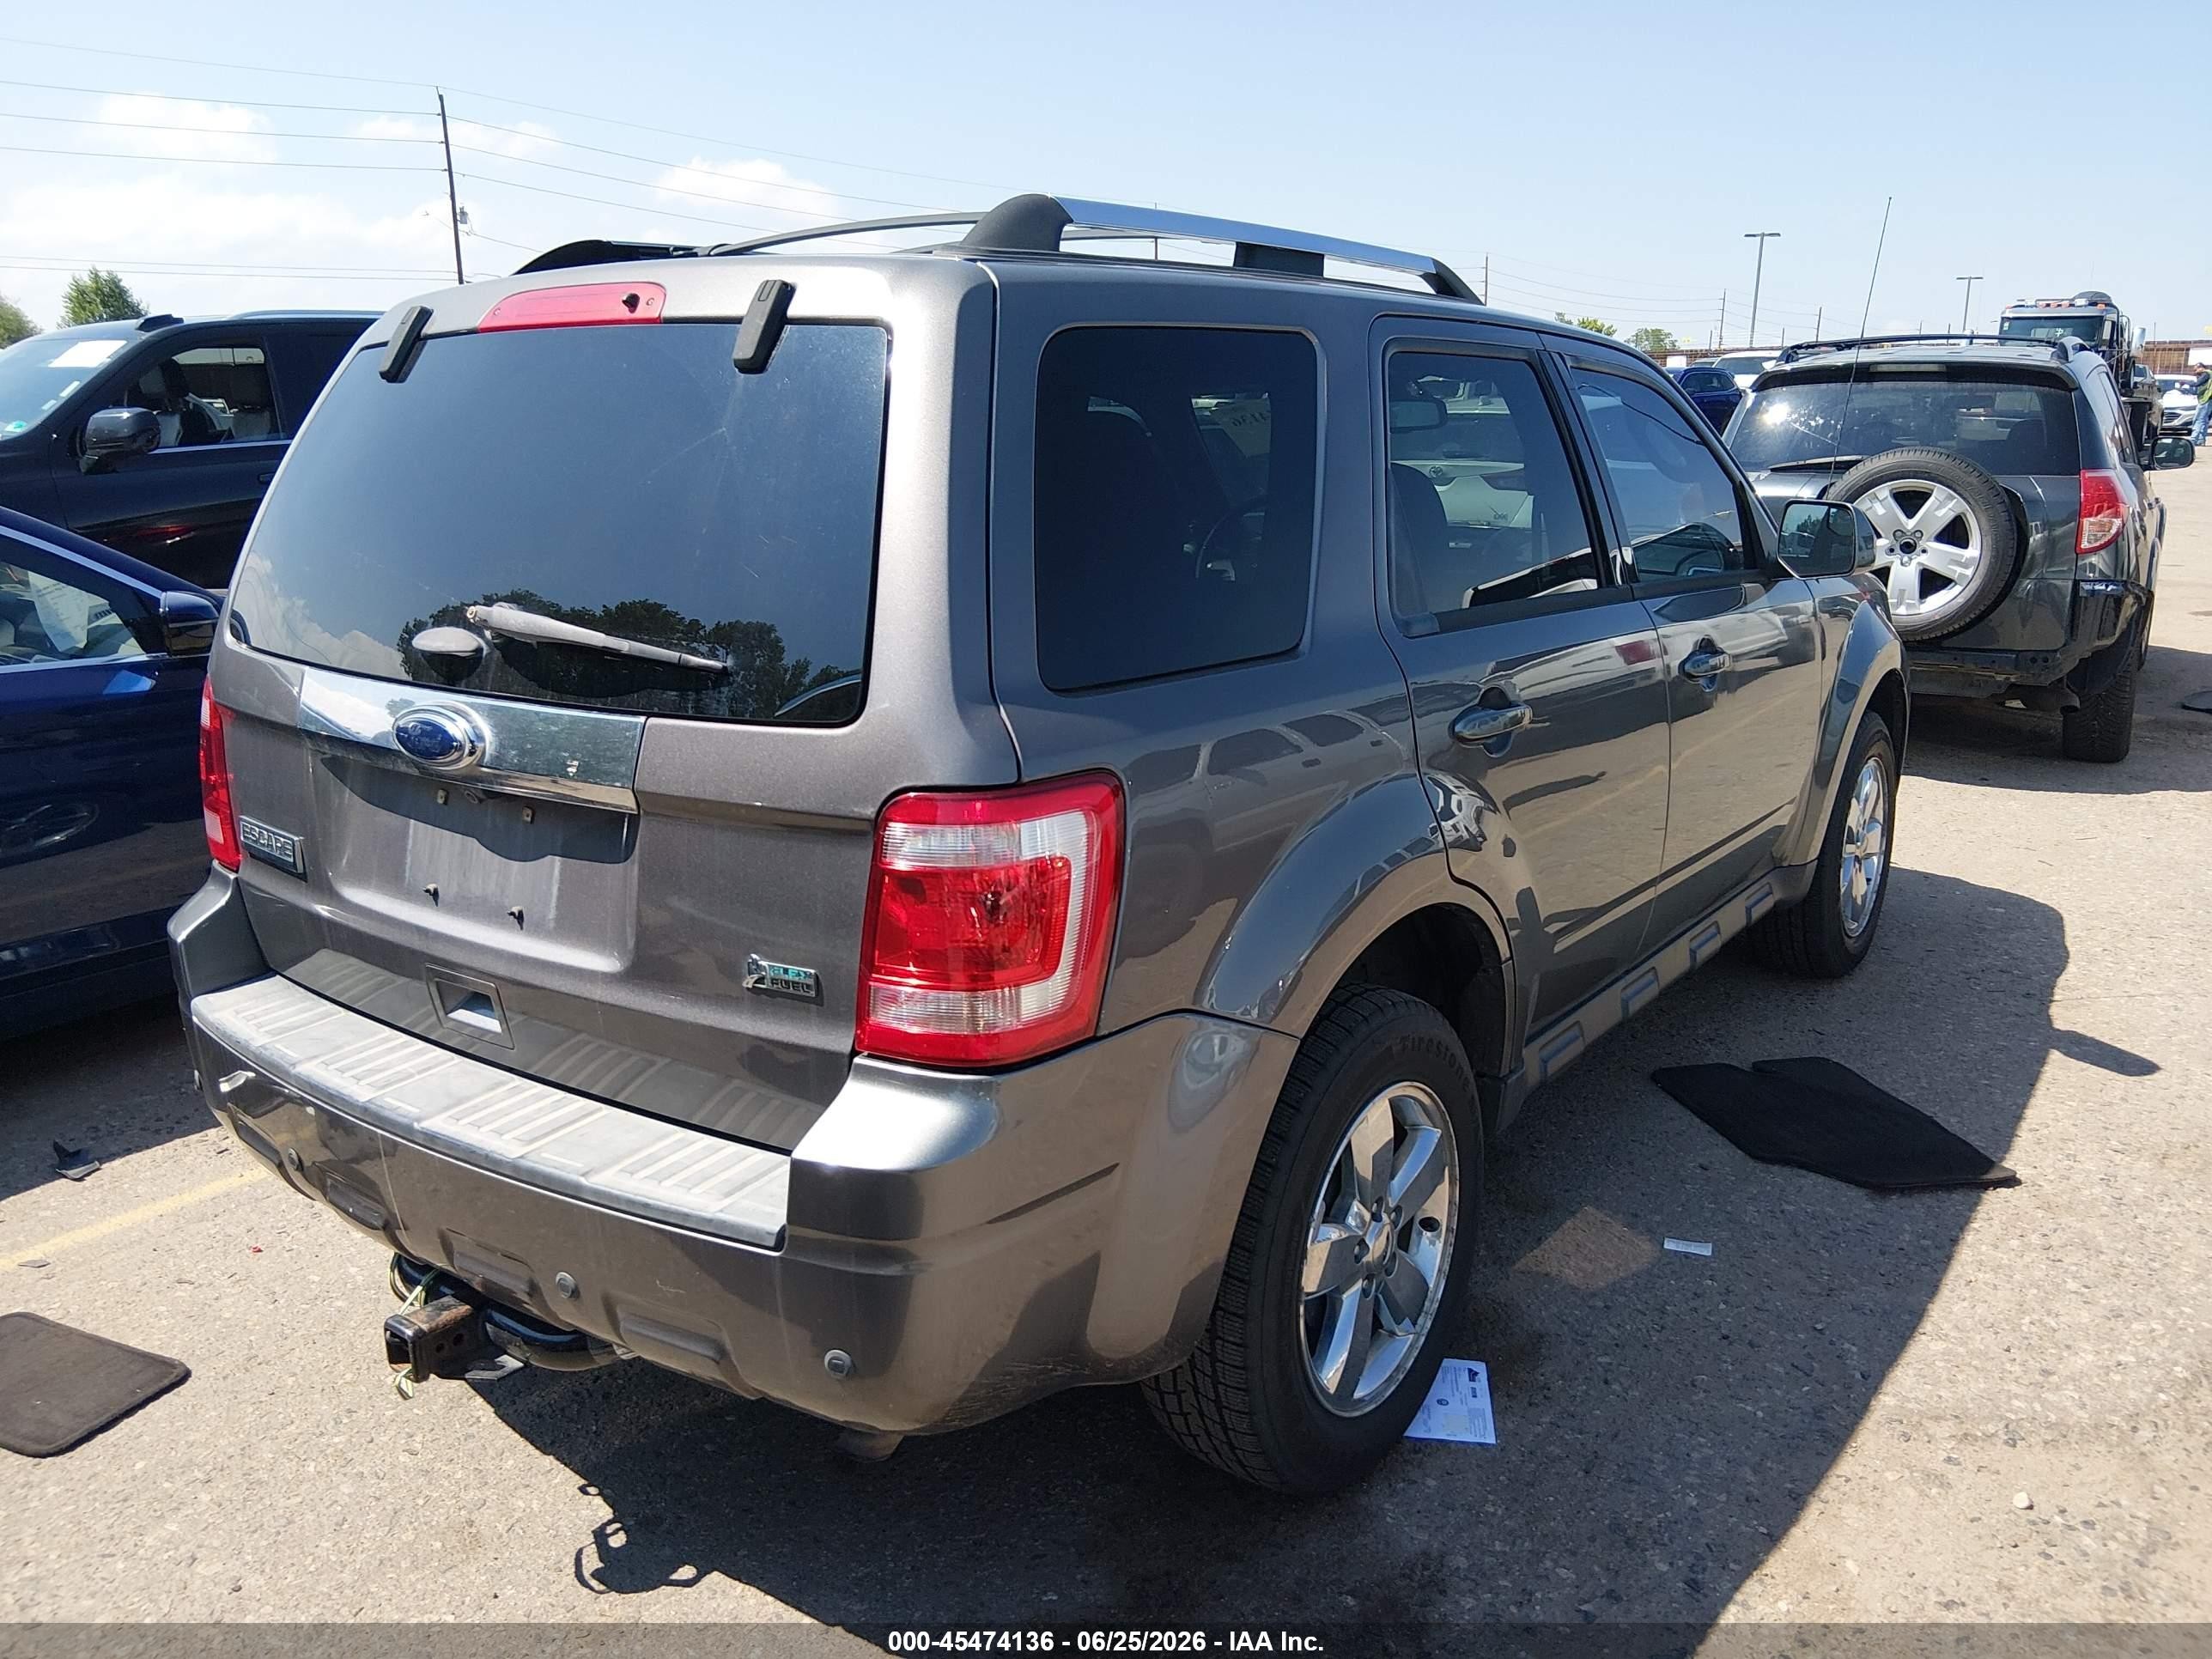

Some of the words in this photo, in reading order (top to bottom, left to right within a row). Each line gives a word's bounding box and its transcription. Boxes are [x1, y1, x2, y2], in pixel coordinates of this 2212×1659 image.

[240, 822, 294, 862] ESCAPE
[769, 966, 812, 981] FLEX
[770, 976, 815, 995] FUEL
